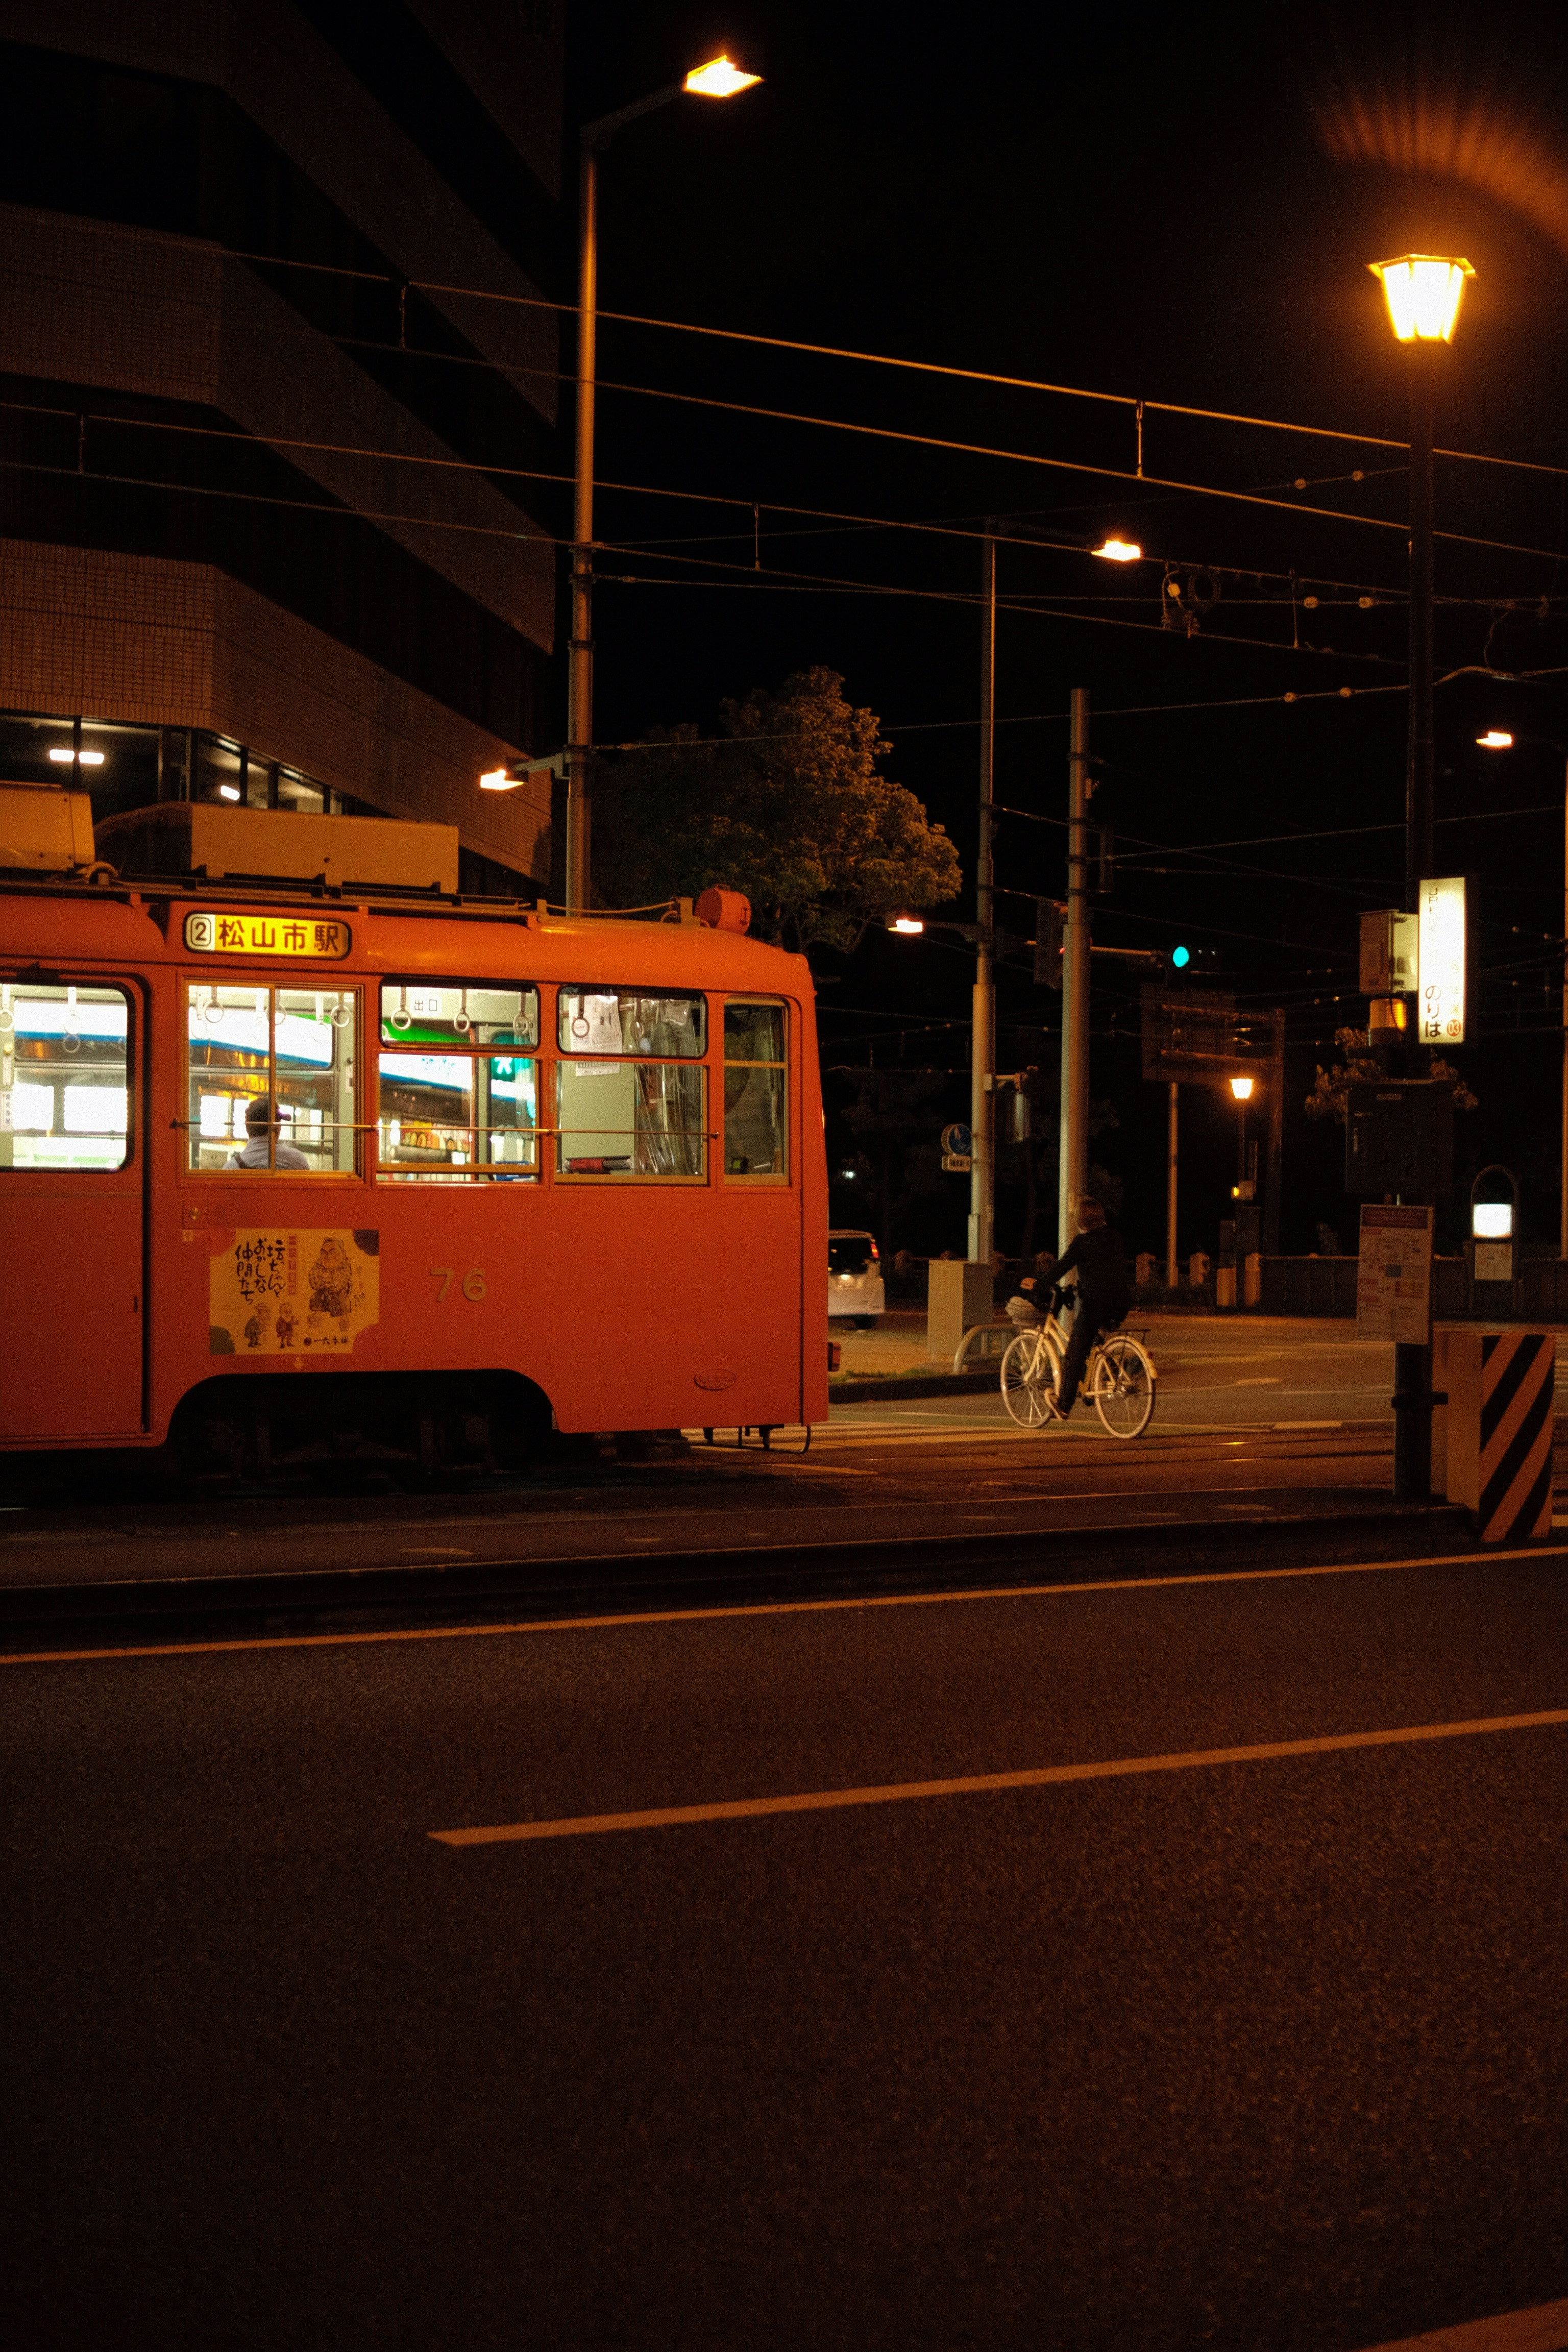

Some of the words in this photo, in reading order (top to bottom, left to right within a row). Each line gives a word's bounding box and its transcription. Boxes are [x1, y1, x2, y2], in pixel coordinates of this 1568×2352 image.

[218, 918, 339, 952] 松山市駅
[414, 998, 437, 1011] 出口
[1425, 985, 1442, 1038] のりば
[1449, 1021, 1460, 1035] 03
[235, 1241, 254, 1305] 仲間たち
[254, 1237, 267, 1294] おかしな
[430, 1267, 487, 1303] 76
